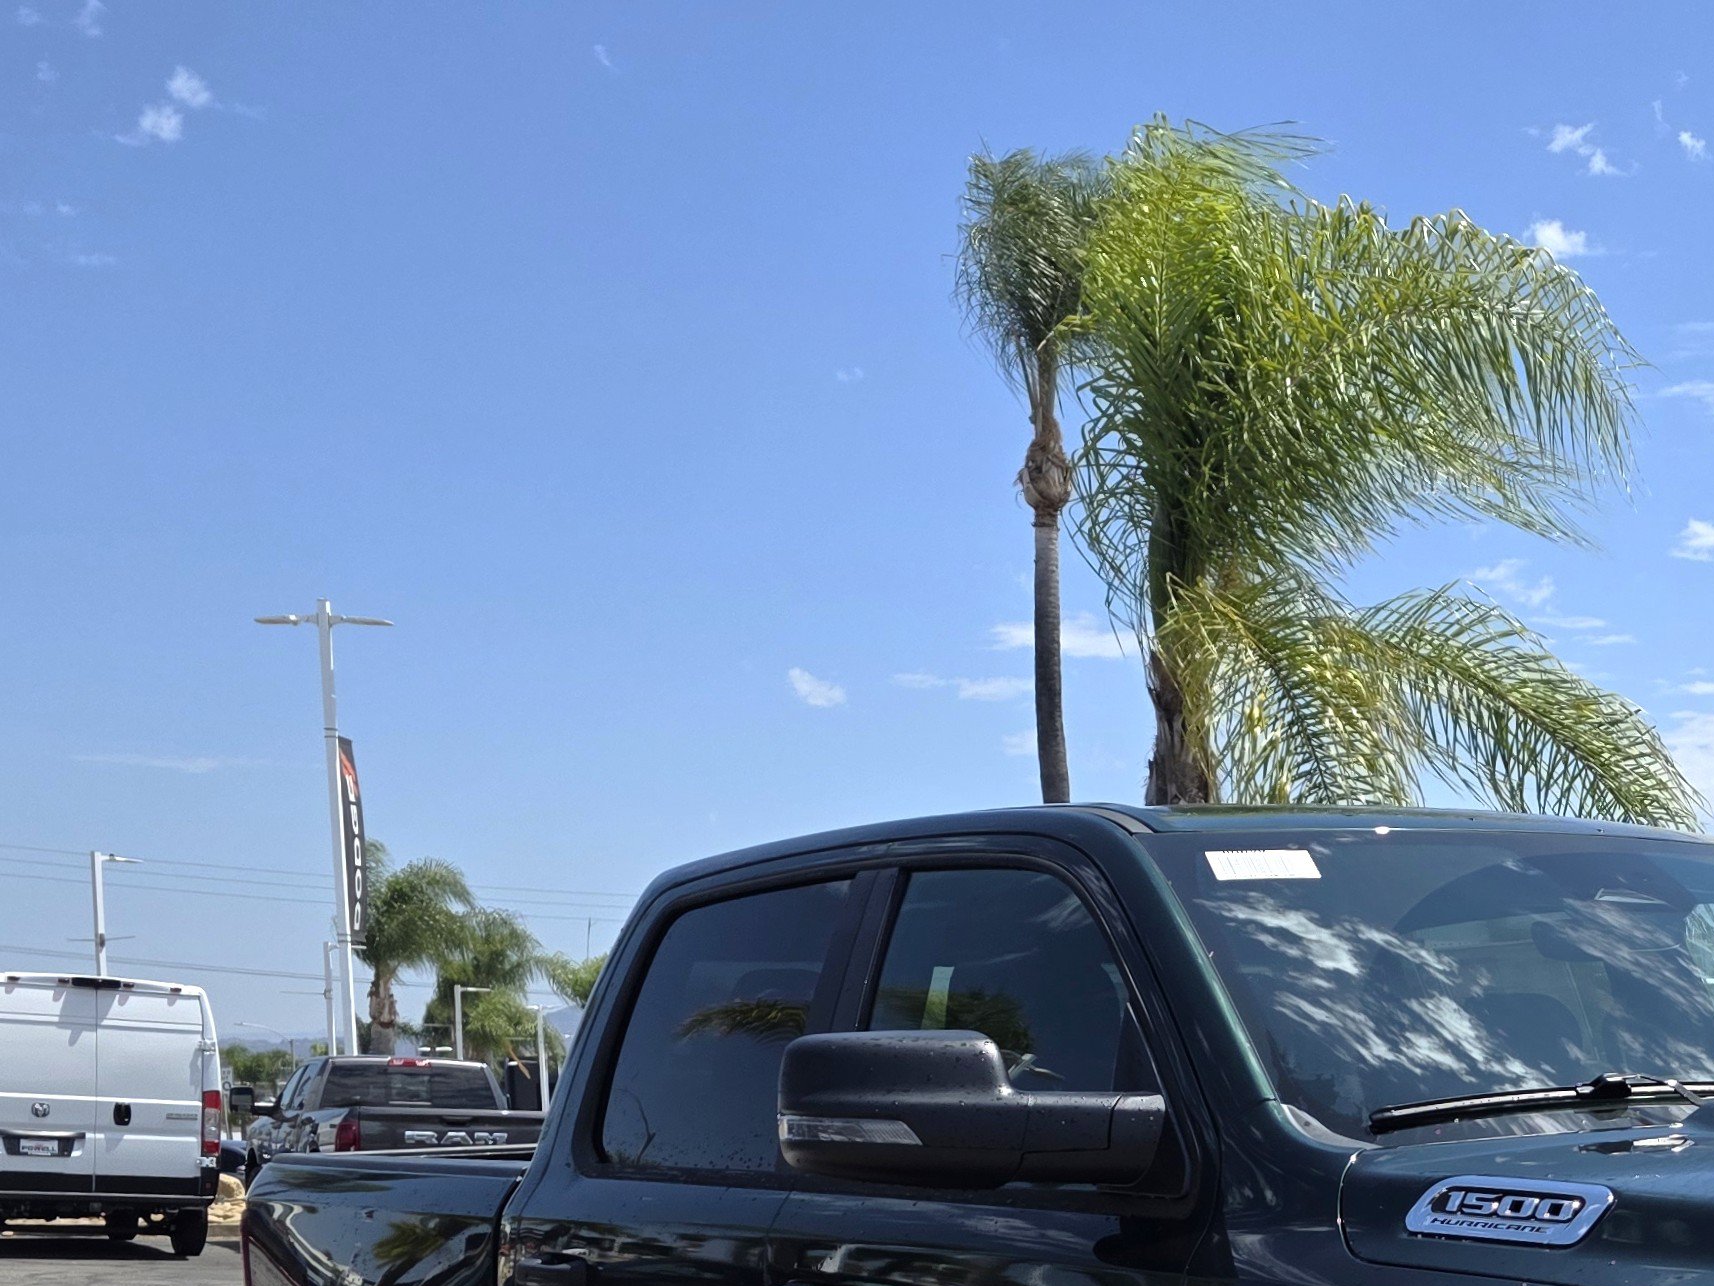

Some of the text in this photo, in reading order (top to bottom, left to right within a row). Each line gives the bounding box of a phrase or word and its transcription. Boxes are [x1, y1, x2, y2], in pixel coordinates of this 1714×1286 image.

[404, 1130, 508, 1145] RAM
[1445, 1190, 1580, 1222] 1500
[1430, 1216, 1550, 1235] HURRICANE
